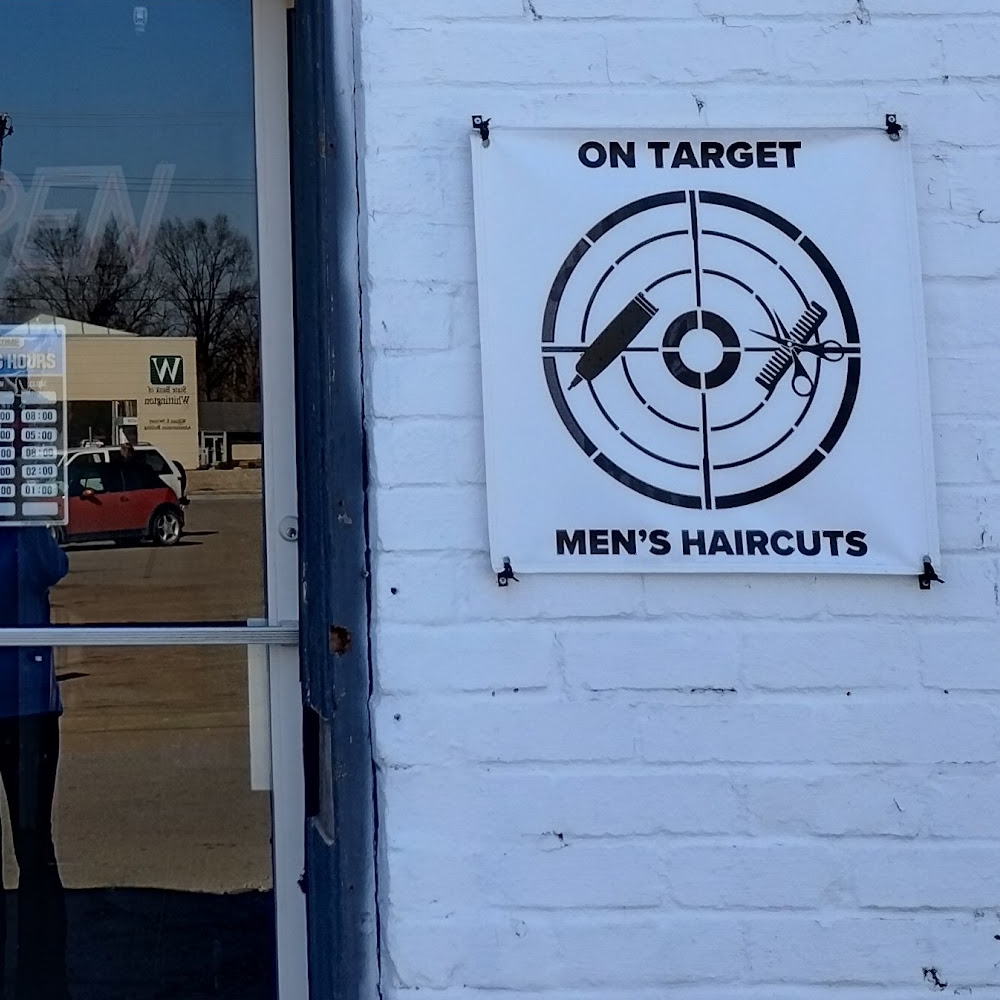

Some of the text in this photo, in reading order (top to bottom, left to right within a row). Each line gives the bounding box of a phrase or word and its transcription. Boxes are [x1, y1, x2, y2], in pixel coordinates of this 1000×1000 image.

[577, 140, 802, 169] ON TARGET
[6, 353, 56, 370] HOURS
[25, 411, 53, 421] 08:00
[25, 430, 53, 440] 05:00
[26, 466, 53, 476] 02:00
[25, 485, 53, 495] 01:00
[555, 528, 868, 557] MEN'S HAIRCUTS
